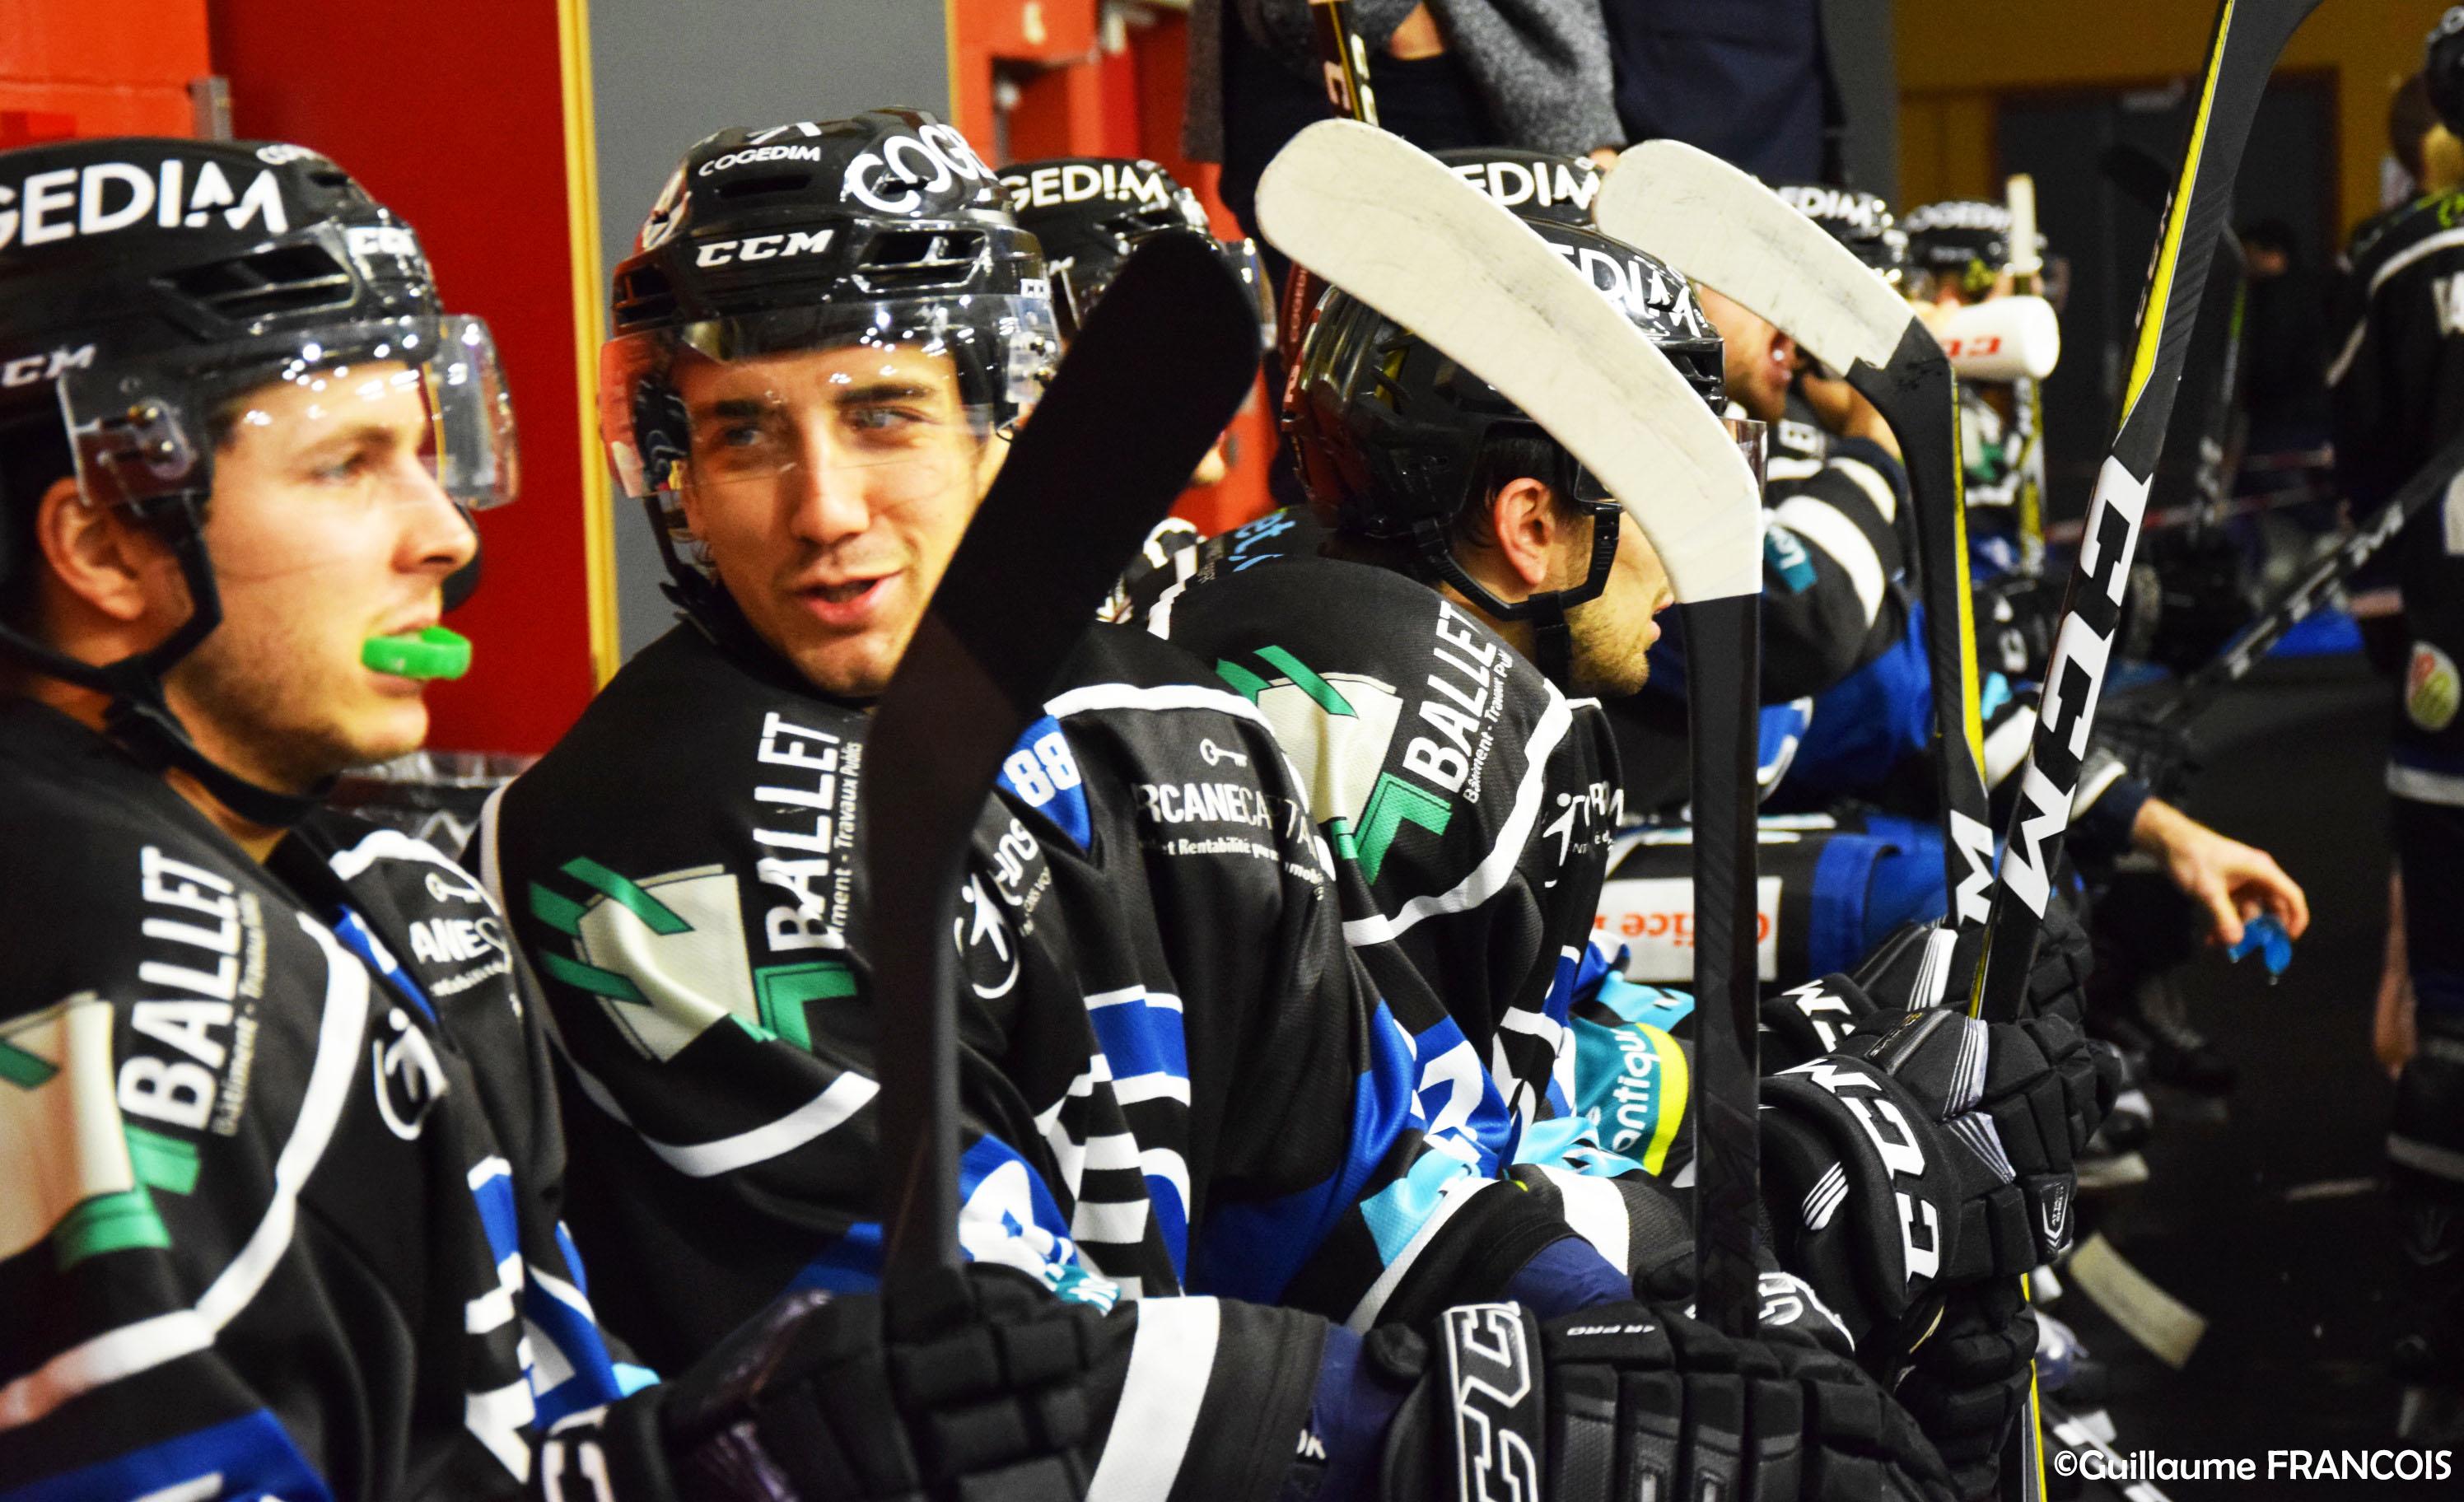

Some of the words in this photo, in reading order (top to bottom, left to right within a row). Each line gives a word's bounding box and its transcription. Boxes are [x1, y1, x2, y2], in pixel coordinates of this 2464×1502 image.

[696, 229, 833, 268] CCM
[698, 145, 821, 176] COGEDIM
[1003, 731, 1082, 808] 88
[1402, 599, 1497, 793] BALLET
[2000, 454, 2154, 921] CCM
[752, 711, 841, 952] BALLET
[117, 845, 242, 1131] BALLET
[1772, 1057, 1941, 1286] CCM
[1566, 1324, 1622, 1336] PRO
